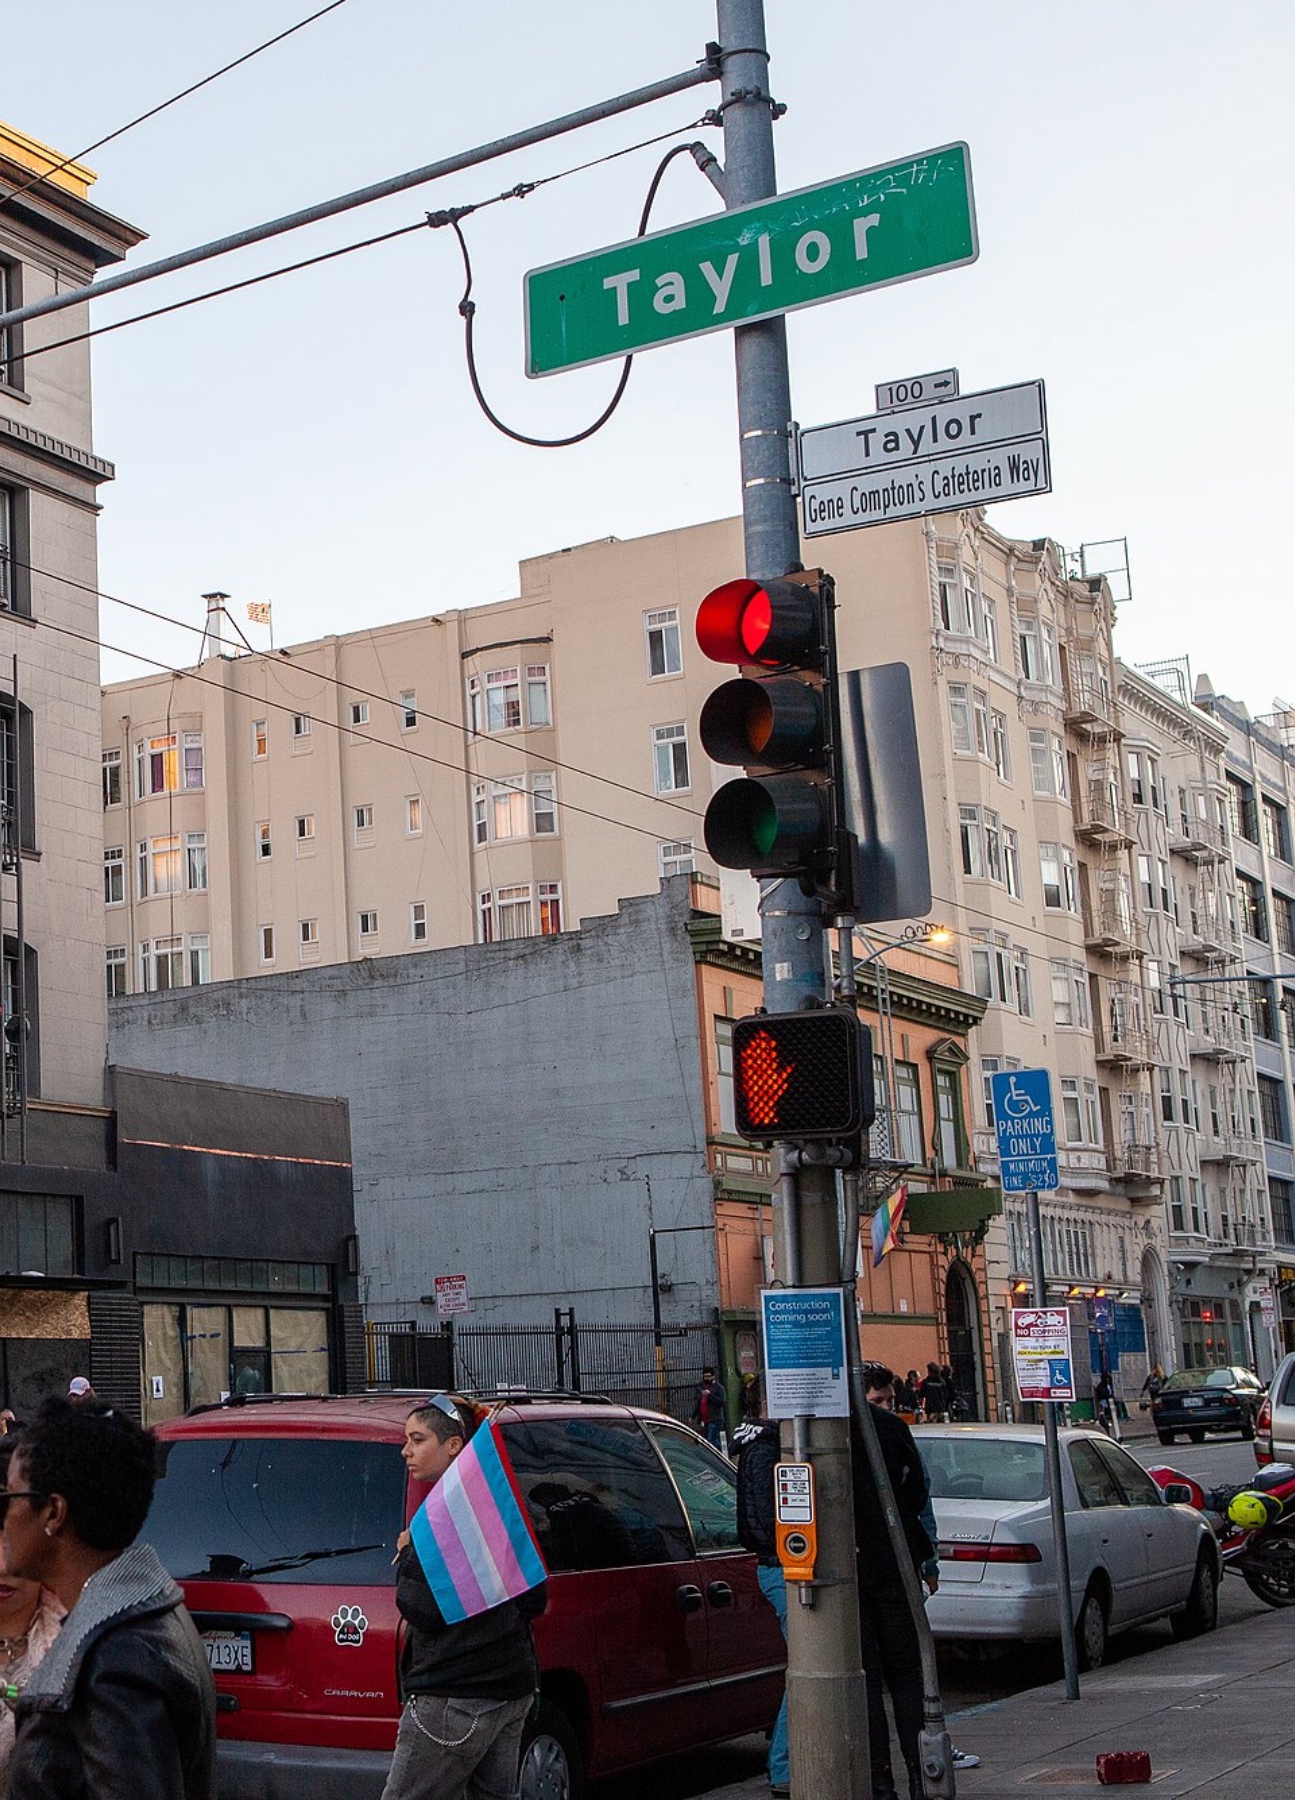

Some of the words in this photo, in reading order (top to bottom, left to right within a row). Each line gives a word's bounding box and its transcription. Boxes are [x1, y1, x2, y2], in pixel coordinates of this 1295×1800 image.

[603, 212, 881, 326] Taylor
[887, 381, 923, 405] 100
[856, 412, 983, 458] Taylor
[808, 494, 844, 523] Gene
[850, 473, 926, 515] Compton's
[931, 459, 1002, 500] Cafeteria
[1007, 453, 1040, 487] Way
[999, 1116, 1051, 1137] PARKING
[1010, 1136, 1041, 1155] ONLY
[1009, 1159, 1049, 1174] MINIMUM
[1005, 1175, 1024, 1188] FINE
[769, 1301, 830, 1311] Construction
[769, 1313, 806, 1324] coming
[807, 1311, 835, 1322] soon!
[1017, 1328, 1029, 1336] NO
[206, 1643, 249, 1666] 713XE
[324, 1688, 384, 1698] CARAVAN
